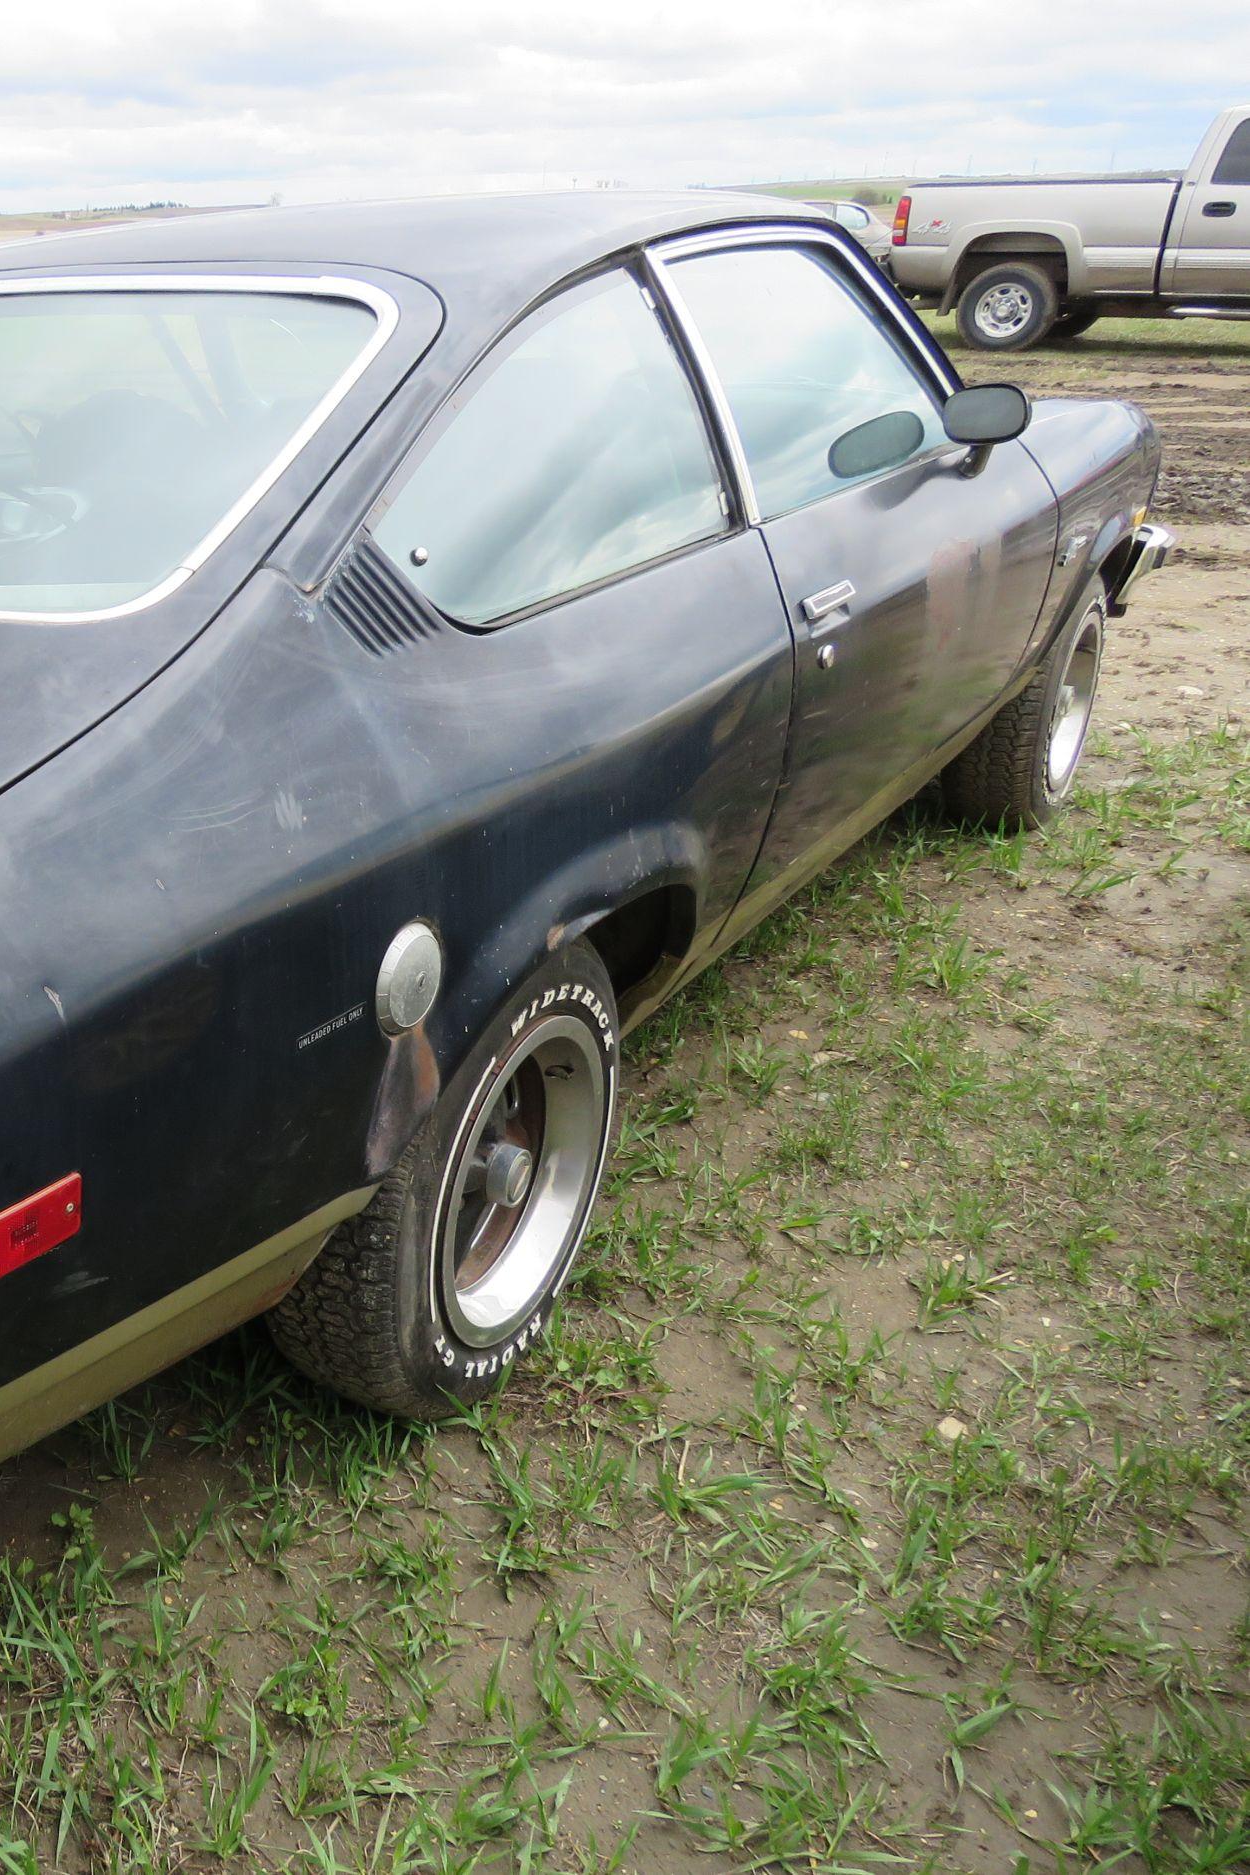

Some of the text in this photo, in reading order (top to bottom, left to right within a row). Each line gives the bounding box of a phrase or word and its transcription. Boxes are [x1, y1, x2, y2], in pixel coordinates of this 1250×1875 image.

[298, 1006, 364, 1049] UNLEADED FUEL ONLY
[510, 984, 614, 1052] WIDETRACK
[464, 1312, 542, 1378] RADIAL
